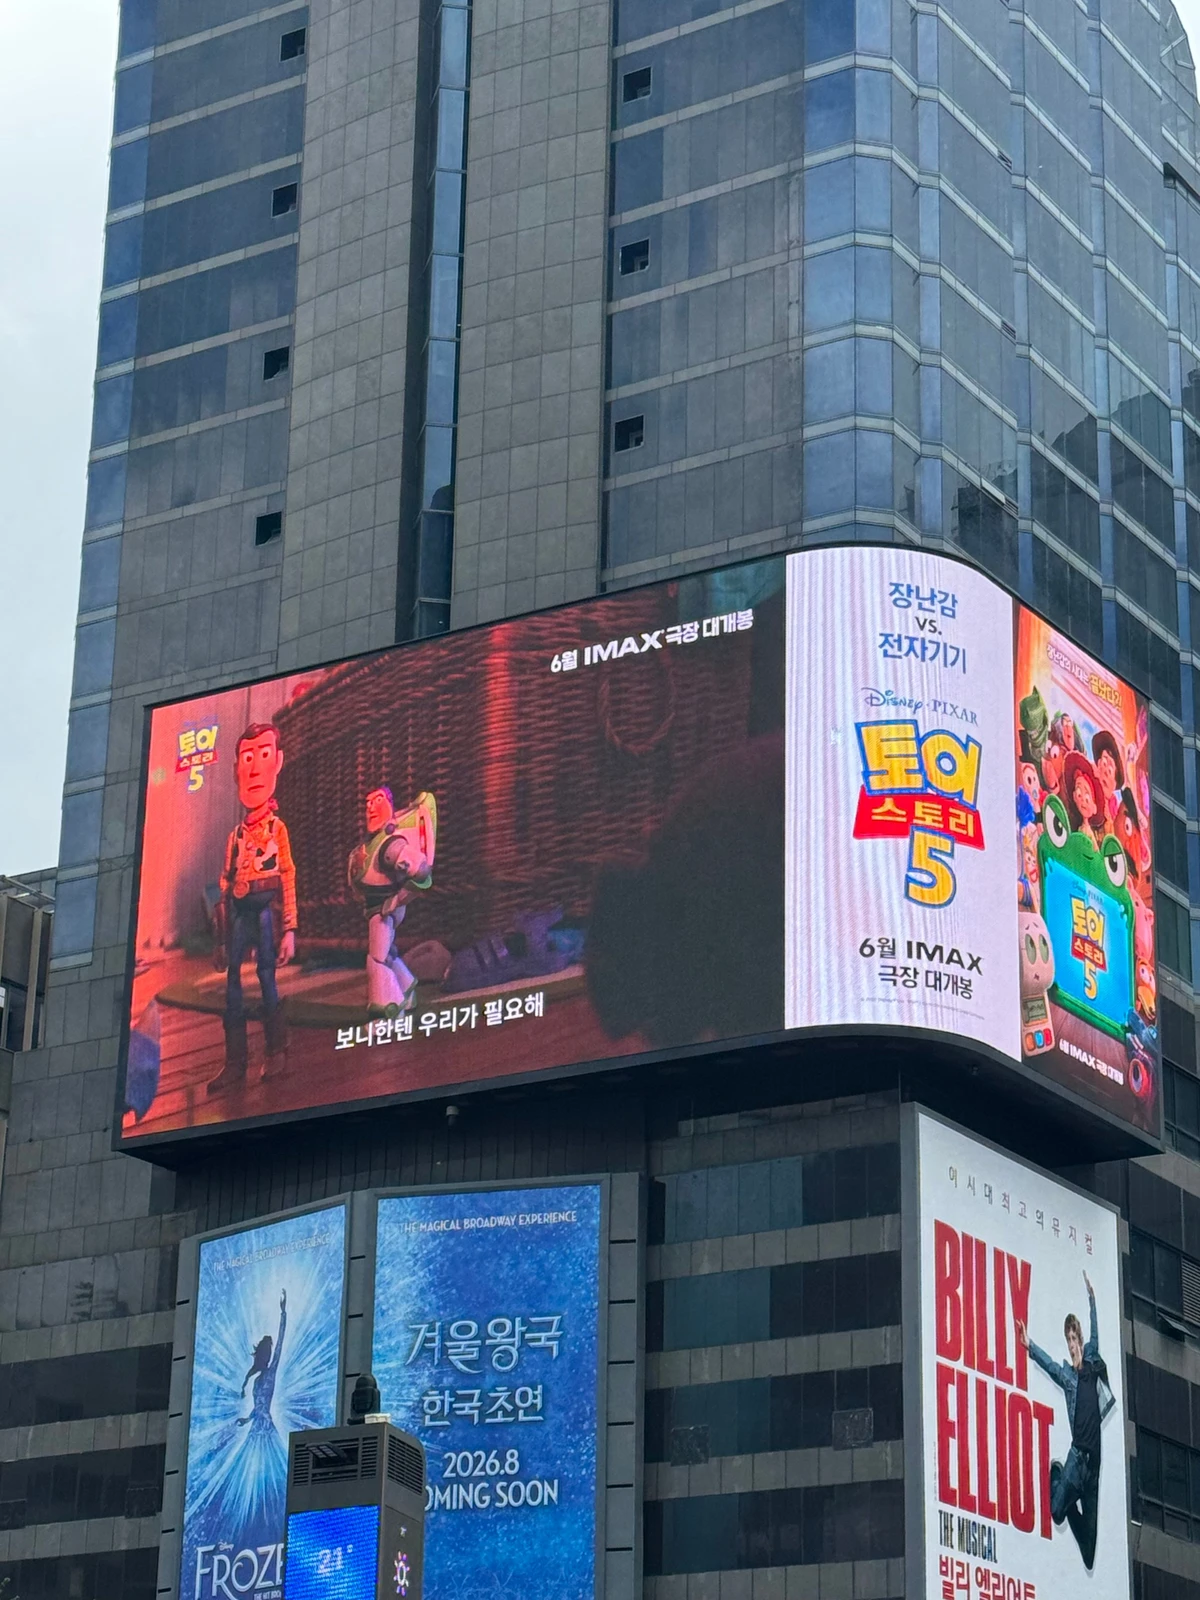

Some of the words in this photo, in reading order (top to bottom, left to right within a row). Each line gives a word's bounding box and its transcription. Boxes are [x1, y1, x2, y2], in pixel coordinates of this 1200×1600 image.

[889, 582, 958, 619] 장난감
[550, 649, 578, 673] 6월
[584, 630, 663, 665] IMAX
[665, 621, 700, 645] 극장
[703, 608, 754, 638] 대개봉
[878, 633, 966, 674] 전자기기
[931, 698, 979, 727] PIXAR
[178, 725, 218, 758] 토이
[180, 752, 214, 768] 스토리
[188, 764, 204, 791] 5
[855, 719, 982, 811] 토이
[871, 797, 975, 838] 스토리
[904, 825, 957, 909] 5
[1070, 895, 1105, 949] 토이
[859, 937, 897, 959] 6월
[906, 940, 984, 976] IMAX
[1074, 938, 1104, 966] 스토리
[878, 965, 920, 988] 극장
[925, 969, 973, 1000] 대개봉
[1084, 958, 1098, 1000] 5
[335, 1015, 413, 1050] 보니한텐
[418, 1003, 479, 1037] 우리가
[483, 992, 544, 1026] 필요해
[1069, 1043, 1097, 1070] IMAX
[399, 1221, 417, 1233] THE
[420, 1219, 462, 1233] MAGICAL
[463, 1214, 517, 1229] BROADWAY
[518, 1210, 577, 1226] EXPERIENCE
[934, 1219, 1031, 1391] BILLY
[405, 1315, 564, 1374] 겨울왕국
[443, 1449, 520, 1478] 2026.8
[936, 1361, 1054, 1540] ELLIOT
[424, 1482, 491, 1512] OMING
[495, 1479, 559, 1507] SOON
[939, 1509, 954, 1549] THE
[957, 1516, 998, 1563] MUSICAL
[195, 1543, 284, 1600] FROZE
[939, 1554, 971, 1600] 빌리
